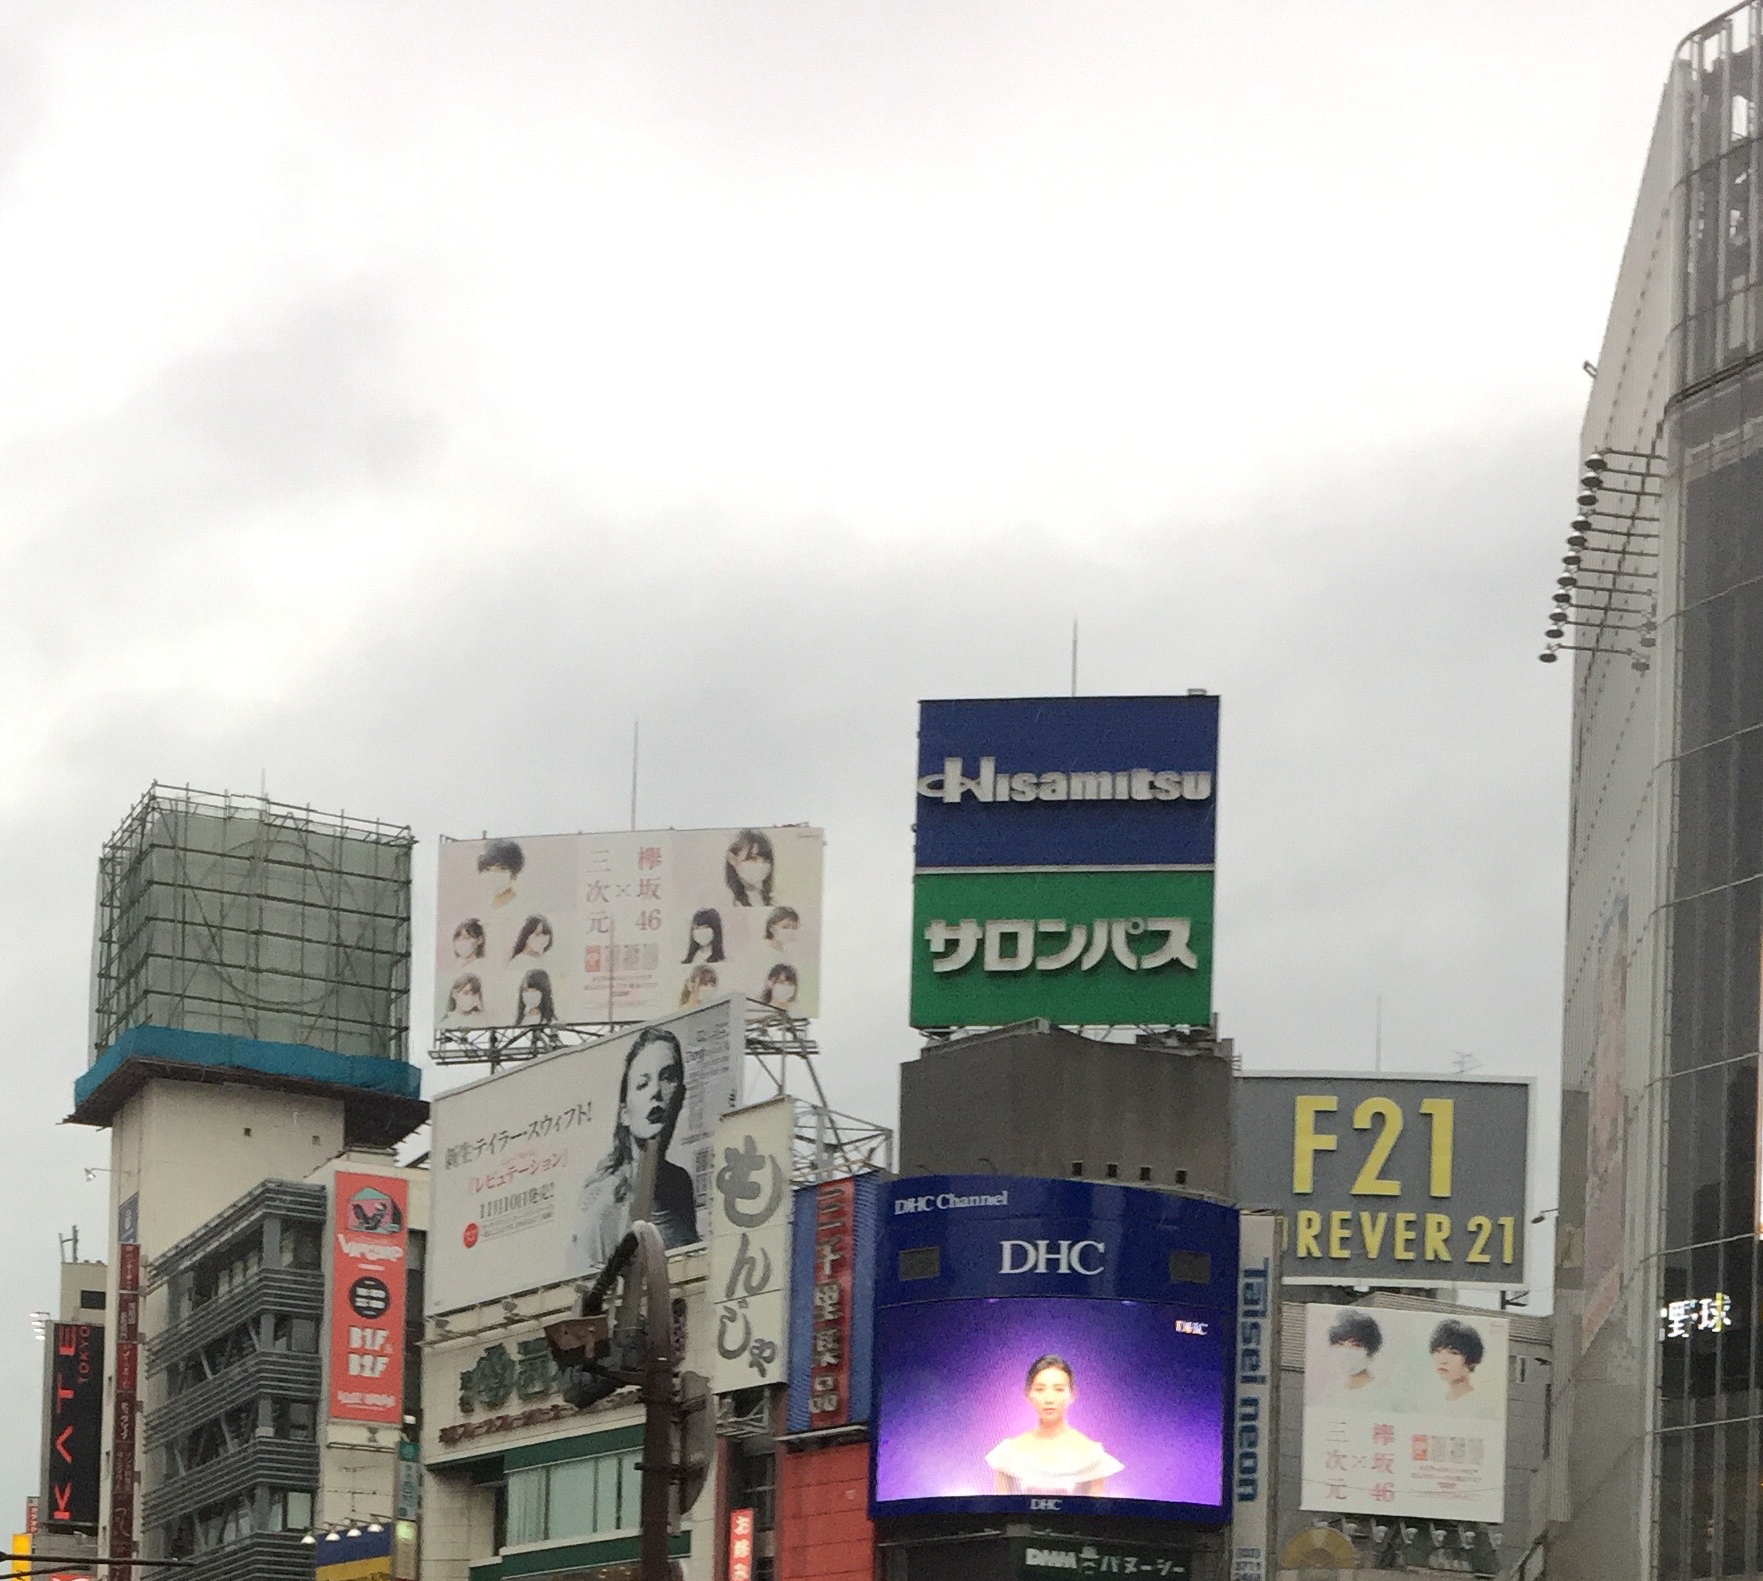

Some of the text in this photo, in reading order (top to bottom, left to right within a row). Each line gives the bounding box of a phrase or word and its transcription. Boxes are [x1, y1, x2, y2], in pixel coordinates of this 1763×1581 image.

[916, 756, 1212, 804] Hisamitsu
[923, 916, 1198, 975] サロンパス
[1292, 1095, 1455, 1198] F21
[895, 1190, 1010, 1215] DHC Channel
[716, 1134, 782, 1377] もんじゃ
[999, 1239, 1106, 1277] DHC
[1280, 1210, 1517, 1266] REVER 21
[1659, 1291, 1733, 1342] 野球
[1029, 1498, 1064, 1512] DHC
